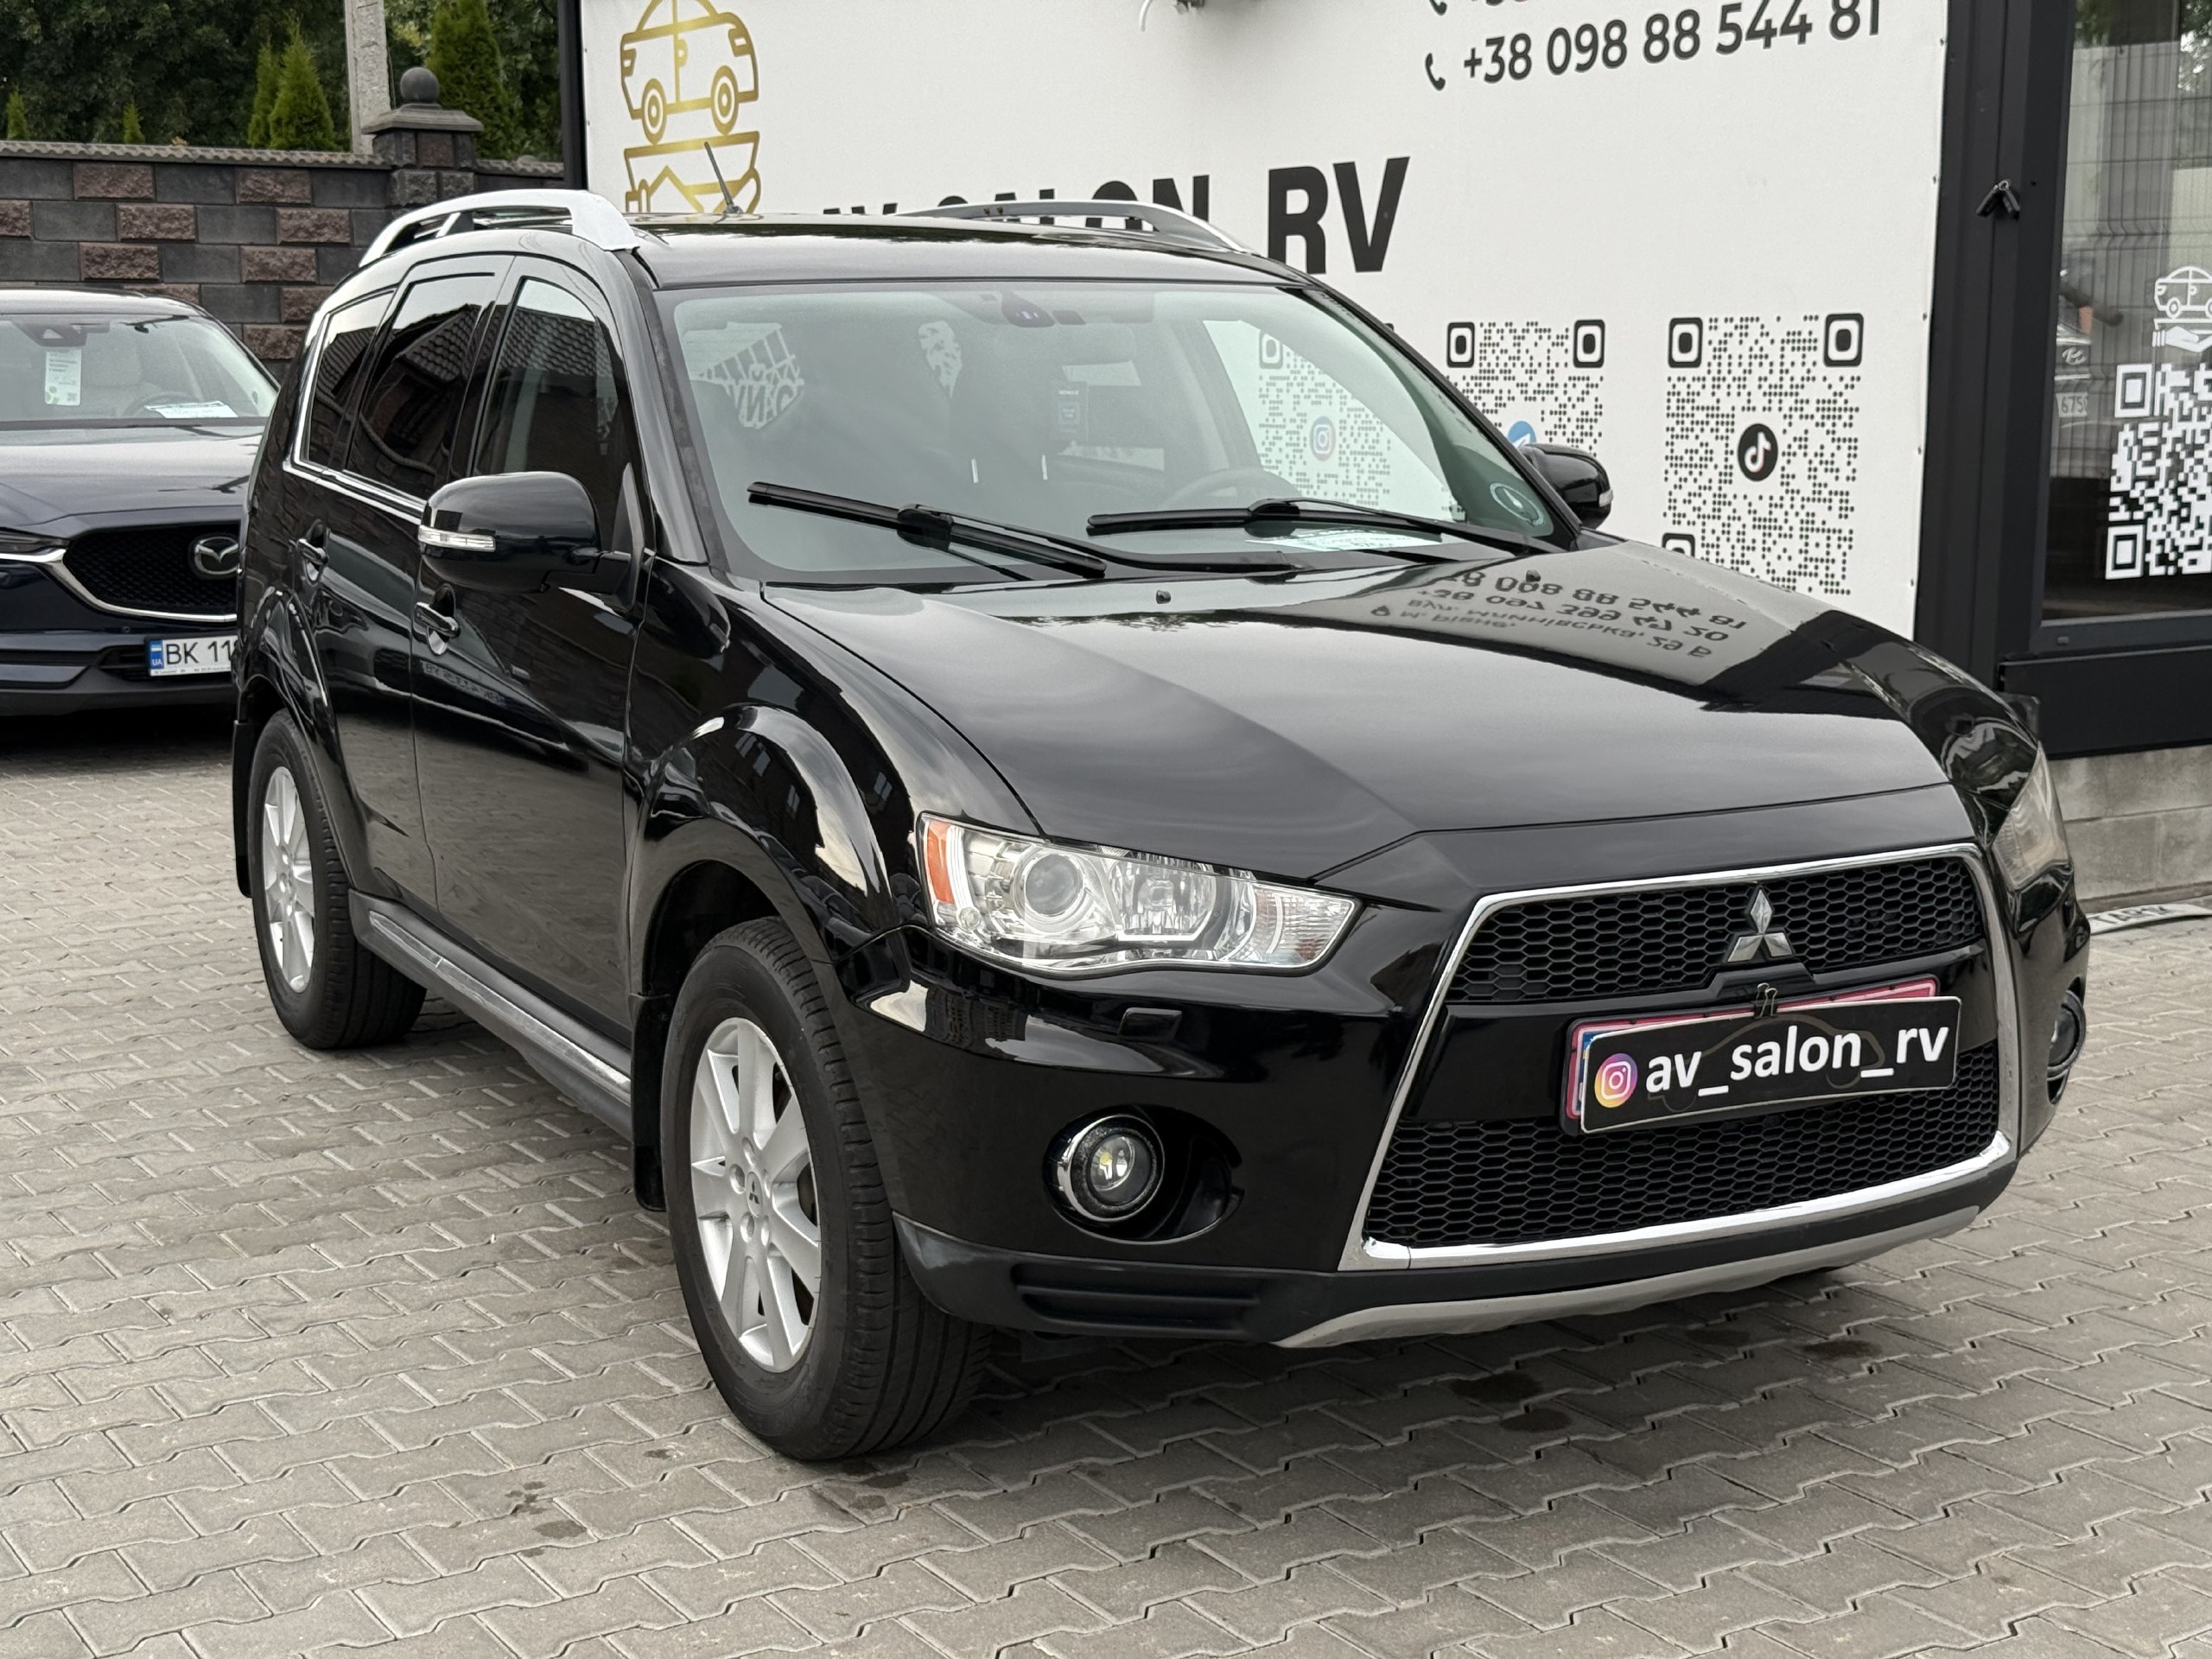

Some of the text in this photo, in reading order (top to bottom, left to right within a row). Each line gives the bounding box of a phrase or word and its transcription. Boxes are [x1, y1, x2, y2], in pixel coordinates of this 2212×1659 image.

[1464, 0, 1879, 84] +38 098 88 544 81
[1268, 156, 1410, 274] RV
[166, 642, 199, 664] BK
[1646, 1026, 1949, 1096] av_salon_rv
